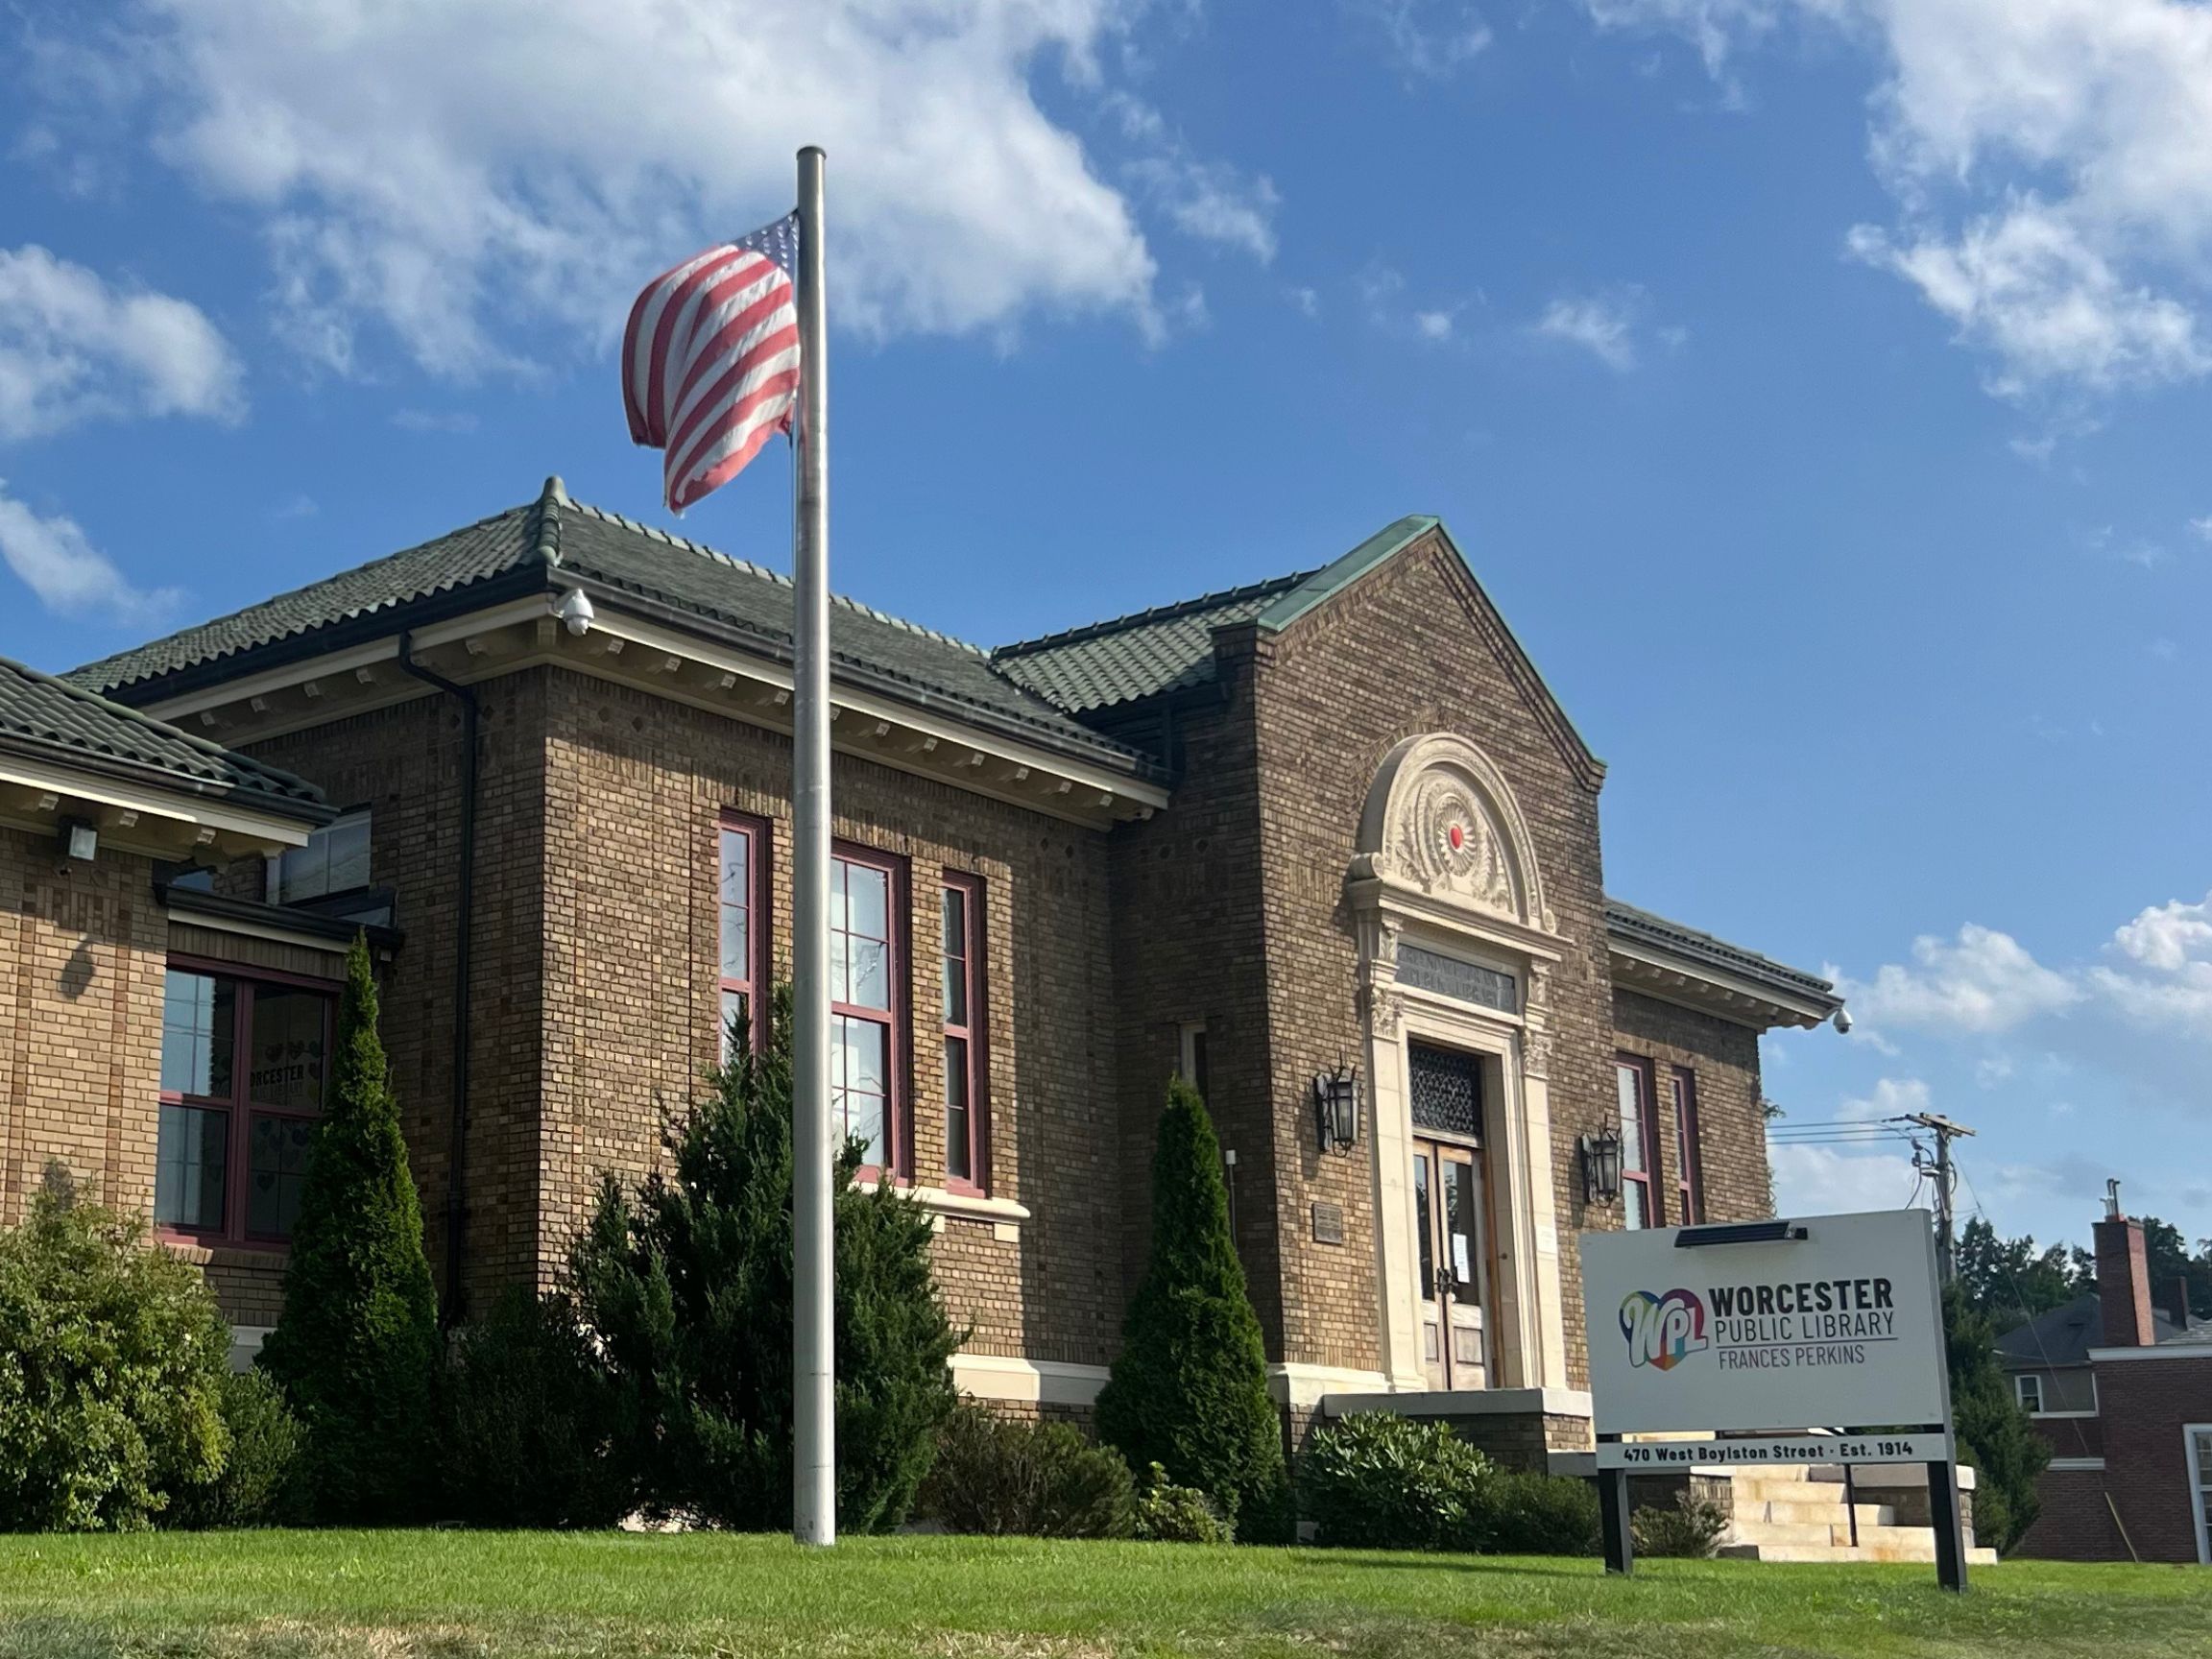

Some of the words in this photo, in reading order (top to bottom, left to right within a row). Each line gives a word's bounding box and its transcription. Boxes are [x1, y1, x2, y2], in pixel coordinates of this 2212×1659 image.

[250, 1065, 304, 1087] ORCESTER
[1708, 1278, 1893, 1317] WORCESTER
[1623, 1296, 1709, 1368] WPL
[1716, 1316, 1792, 1343] PUBLIC
[1802, 1311, 1894, 1339] LIBRARY
[1719, 1348, 1791, 1370] FRANCES
[1795, 1344, 1864, 1366] PERKINS
[1623, 1448, 1649, 1462] 470
[1655, 1447, 1694, 1461] West
[1698, 1446, 1768, 1463] Boylston
[1773, 1444, 1824, 1458] Street
[1839, 1442, 1872, 1456] Est.
[1877, 1441, 1913, 1456] 1914
